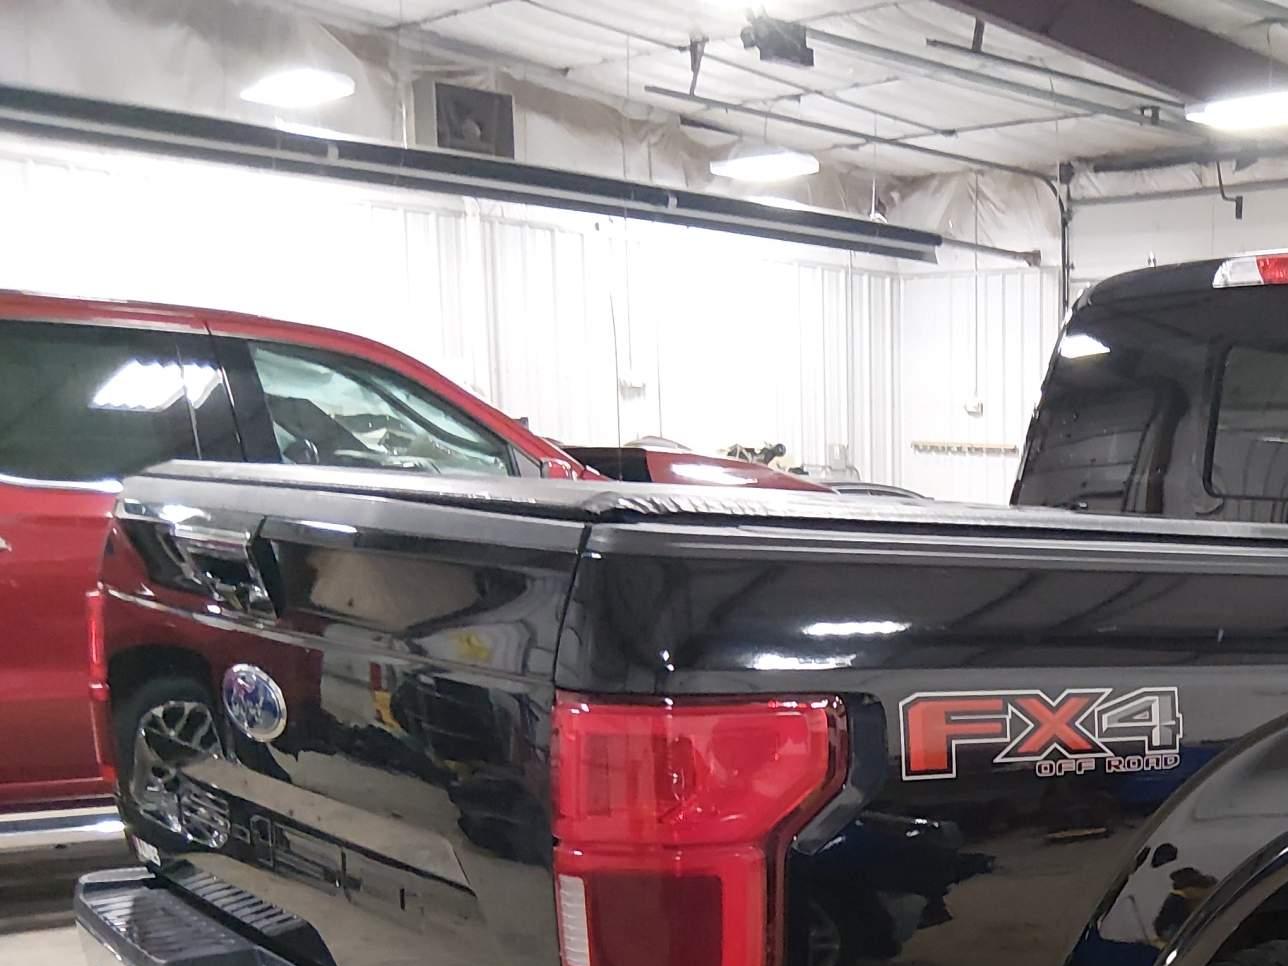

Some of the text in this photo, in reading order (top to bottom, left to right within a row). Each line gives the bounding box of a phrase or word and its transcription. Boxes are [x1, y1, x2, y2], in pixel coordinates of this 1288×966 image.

[900, 687, 1183, 780] FX4
[1035, 753, 1180, 777] OFF ROAD
